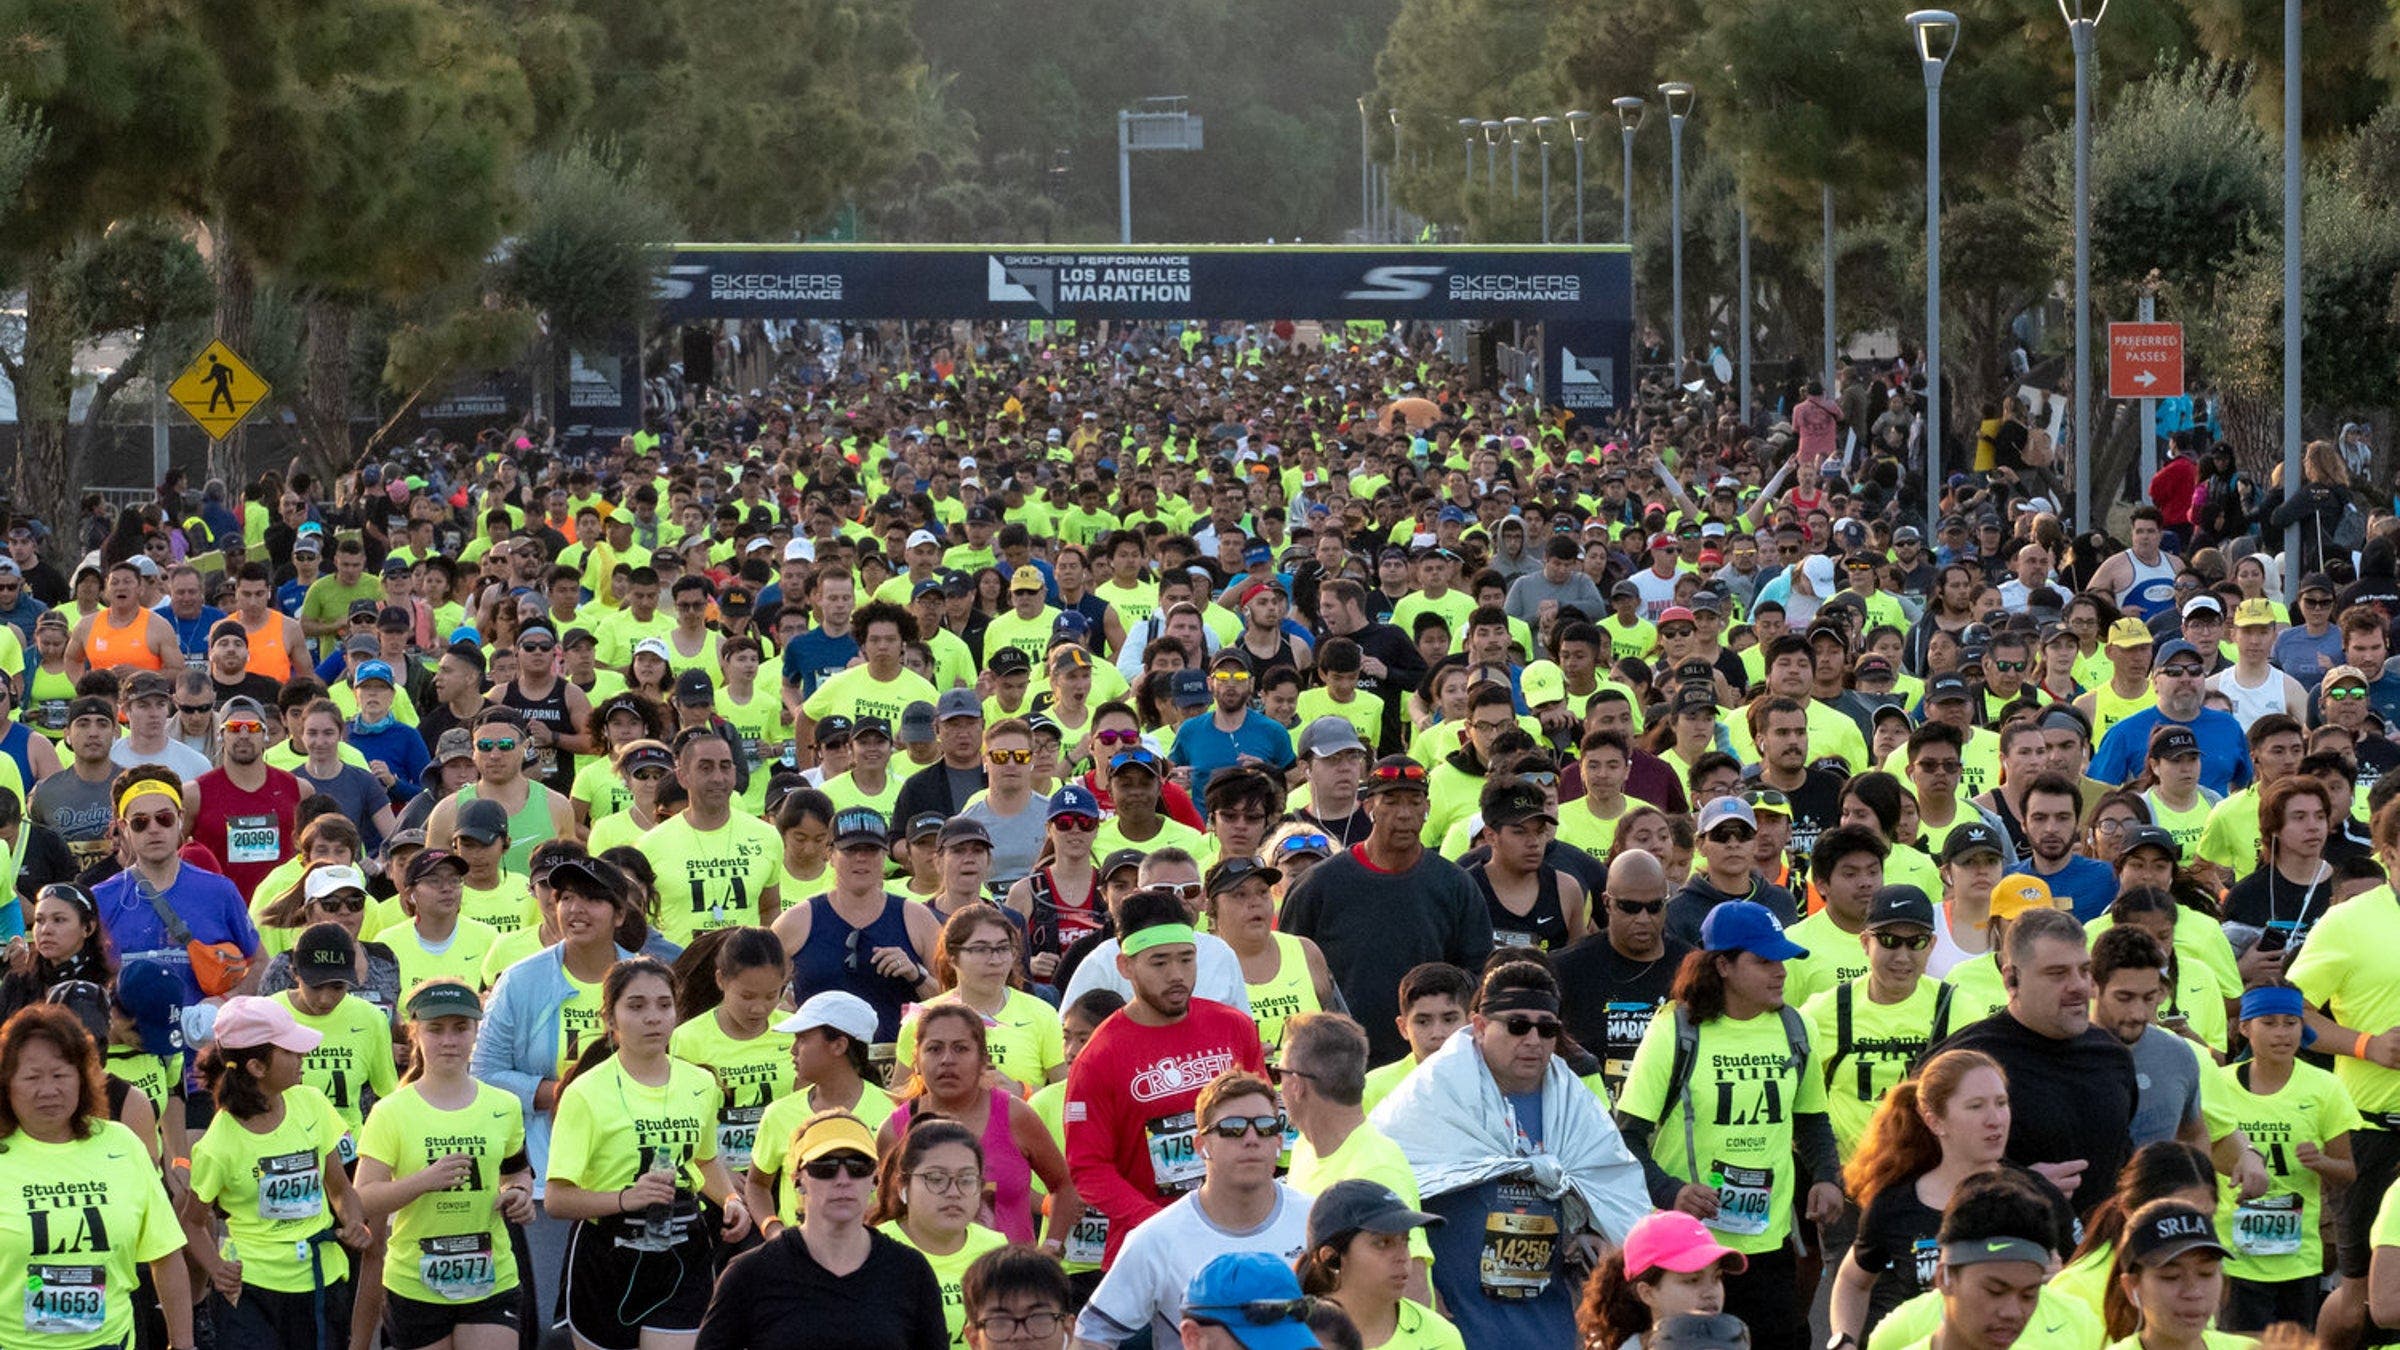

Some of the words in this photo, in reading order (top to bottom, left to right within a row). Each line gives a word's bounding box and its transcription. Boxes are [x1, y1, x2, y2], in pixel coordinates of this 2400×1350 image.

[1004, 256, 1074, 265] SKECHERS
[1079, 256, 1190, 265] PERFORMANCE
[711, 274, 842, 290] SKECHERS
[1060, 269, 1098, 283] LOS
[1105, 269, 1190, 283] ANGELES
[1449, 275, 1580, 290] SKECHERS
[711, 290, 842, 300] PERFORMANCE
[1060, 285, 1191, 302] MARATHON
[1449, 291, 1580, 300] PERFORMANCE
[2115, 336, 2177, 346] PREFERRED
[2126, 351, 2167, 362] PASSES
[457, 403, 506, 413] ANGELES
[2169, 735, 2193, 747] SRLA
[235, 830, 274, 849] 20399
[686, 857, 750, 869] Students
[689, 877, 748, 913] LA
[314, 950, 346, 965] SRLA
[1713, 1053, 1785, 1068] Students
[719, 1062, 778, 1078] Students
[1713, 1080, 1783, 1125] LA
[635, 1118, 700, 1133] Students
[2239, 1120, 2292, 1133] tudents
[425, 1135, 487, 1148] Students
[721, 1128, 757, 1151] 425
[1161, 1134, 1195, 1160] 179
[22, 1181, 108, 1198] Students
[266, 1177, 320, 1200] 42574
[28, 1206, 111, 1256] LA
[1073, 1222, 1107, 1243] 425
[2156, 1216, 2209, 1240] SRLA
[2240, 1214, 2297, 1236] 40791
[1495, 1237, 1550, 1264] 14259
[427, 1256, 488, 1281] 42577
[31, 1290, 100, 1315] 41653
